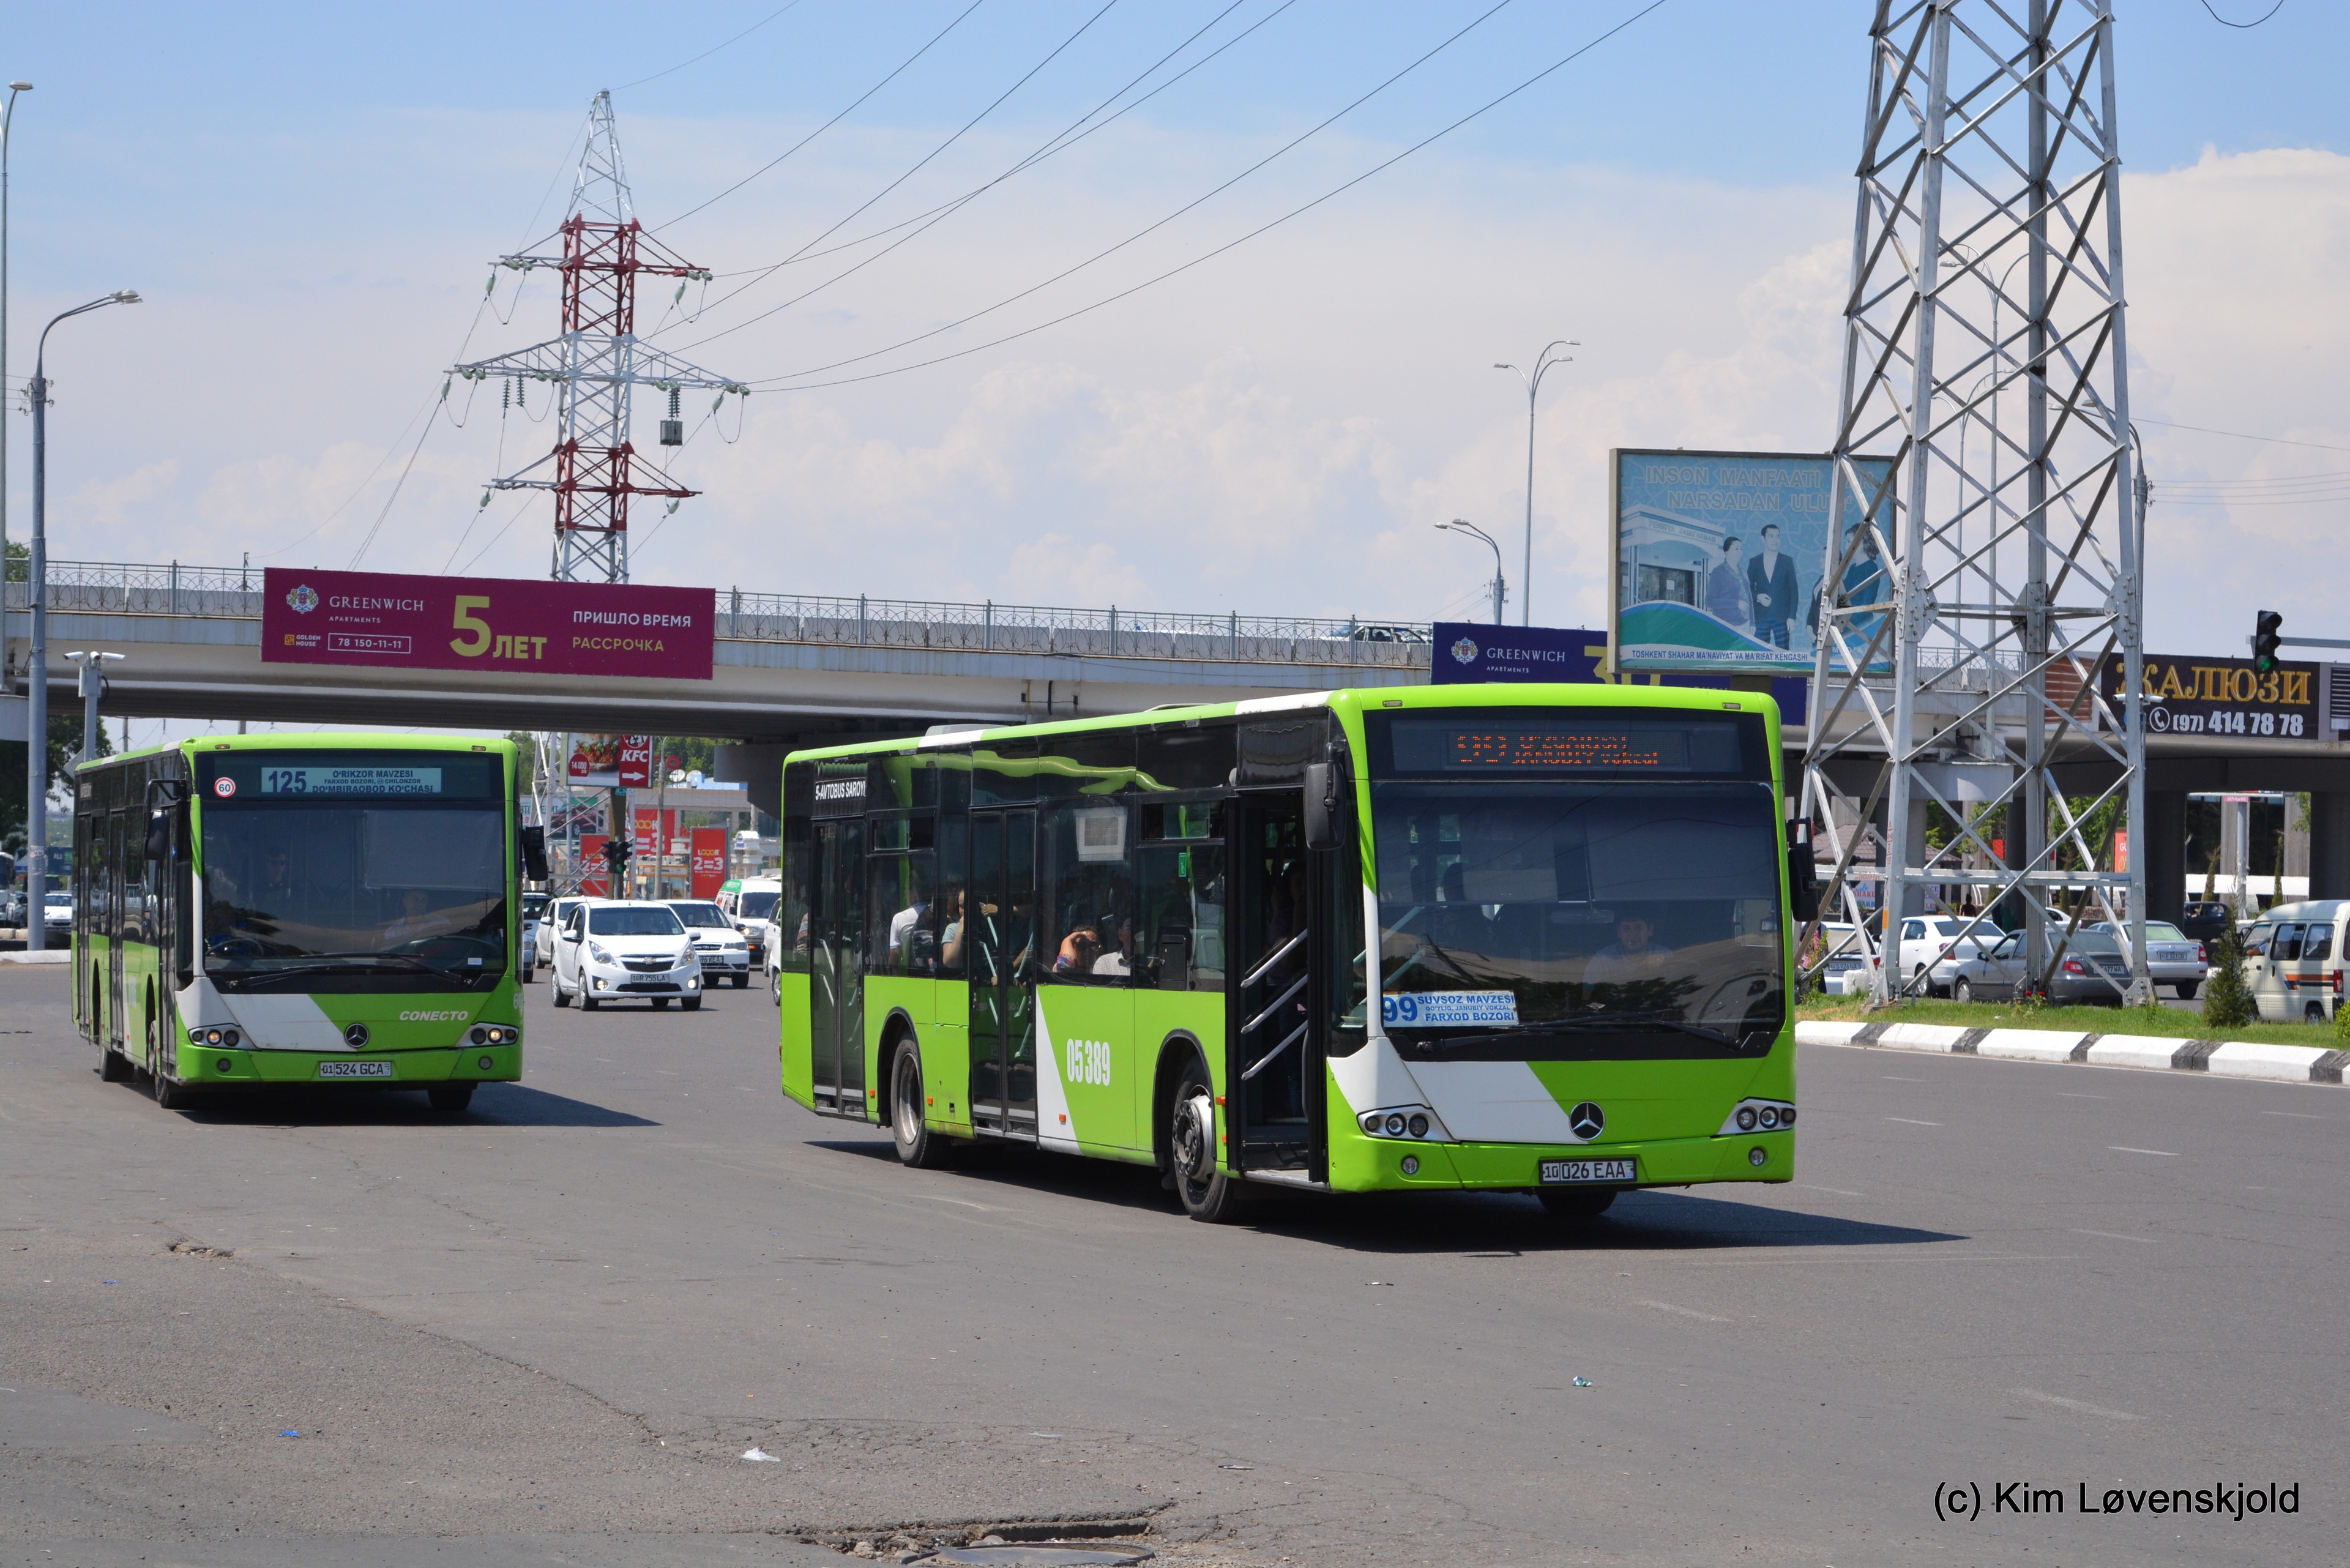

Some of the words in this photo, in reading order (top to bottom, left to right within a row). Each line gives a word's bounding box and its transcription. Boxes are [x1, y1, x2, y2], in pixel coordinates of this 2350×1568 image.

[1646, 466, 1708, 485] INSON
[1720, 468, 1821, 488] MANFAATI
[1667, 491, 1780, 511] NARSADAN
[329, 595, 423, 611] GREENWICH
[573, 611, 640, 625] ПРИШЛО
[643, 614, 692, 627] ВРЕМЯ
[450, 595, 491, 657] 5
[493, 635, 547, 660] ЛЕТ
[355, 639, 401, 649] 150-11-11
[573, 637, 664, 652] РАССРОЧКА
[1486, 648, 1565, 663] GREENWICH
[1632, 650, 1666, 659] TOSHKENT
[1668, 651, 1695, 659] SHAHAR
[1696, 651, 1733, 660] MA'NAVIYAT
[1745, 652, 1773, 661] MA'RIFAT
[1775, 653, 1808, 662] KENGASHI
[2173, 714, 2203, 731] (97)
[2209, 711, 2245, 733] 414
[2250, 713, 2274, 735] 78
[2279, 714, 2303, 736] 78
[621, 750, 649, 763] KFC
[218, 783, 231, 792] 60
[268, 771, 306, 793] 125
[815, 782, 845, 801] 5-AVTOBUS
[1417, 996, 1463, 1004] SUVSOZ
[1467, 995, 1514, 1004] MAVZESI
[399, 1011, 468, 1021] CONECTO
[1383, 996, 1418, 1022] 99
[1425, 1013, 1469, 1021] FARXOD
[1473, 1012, 1514, 1021] BOZORI
[323, 1065, 333, 1074] 01
[335, 1064, 356, 1075] 524
[360, 1063, 384, 1075] GCA
[1545, 1165, 1559, 1178] 10
[1562, 1163, 1589, 1179] 026
[1594, 1162, 1625, 1178] EAA
